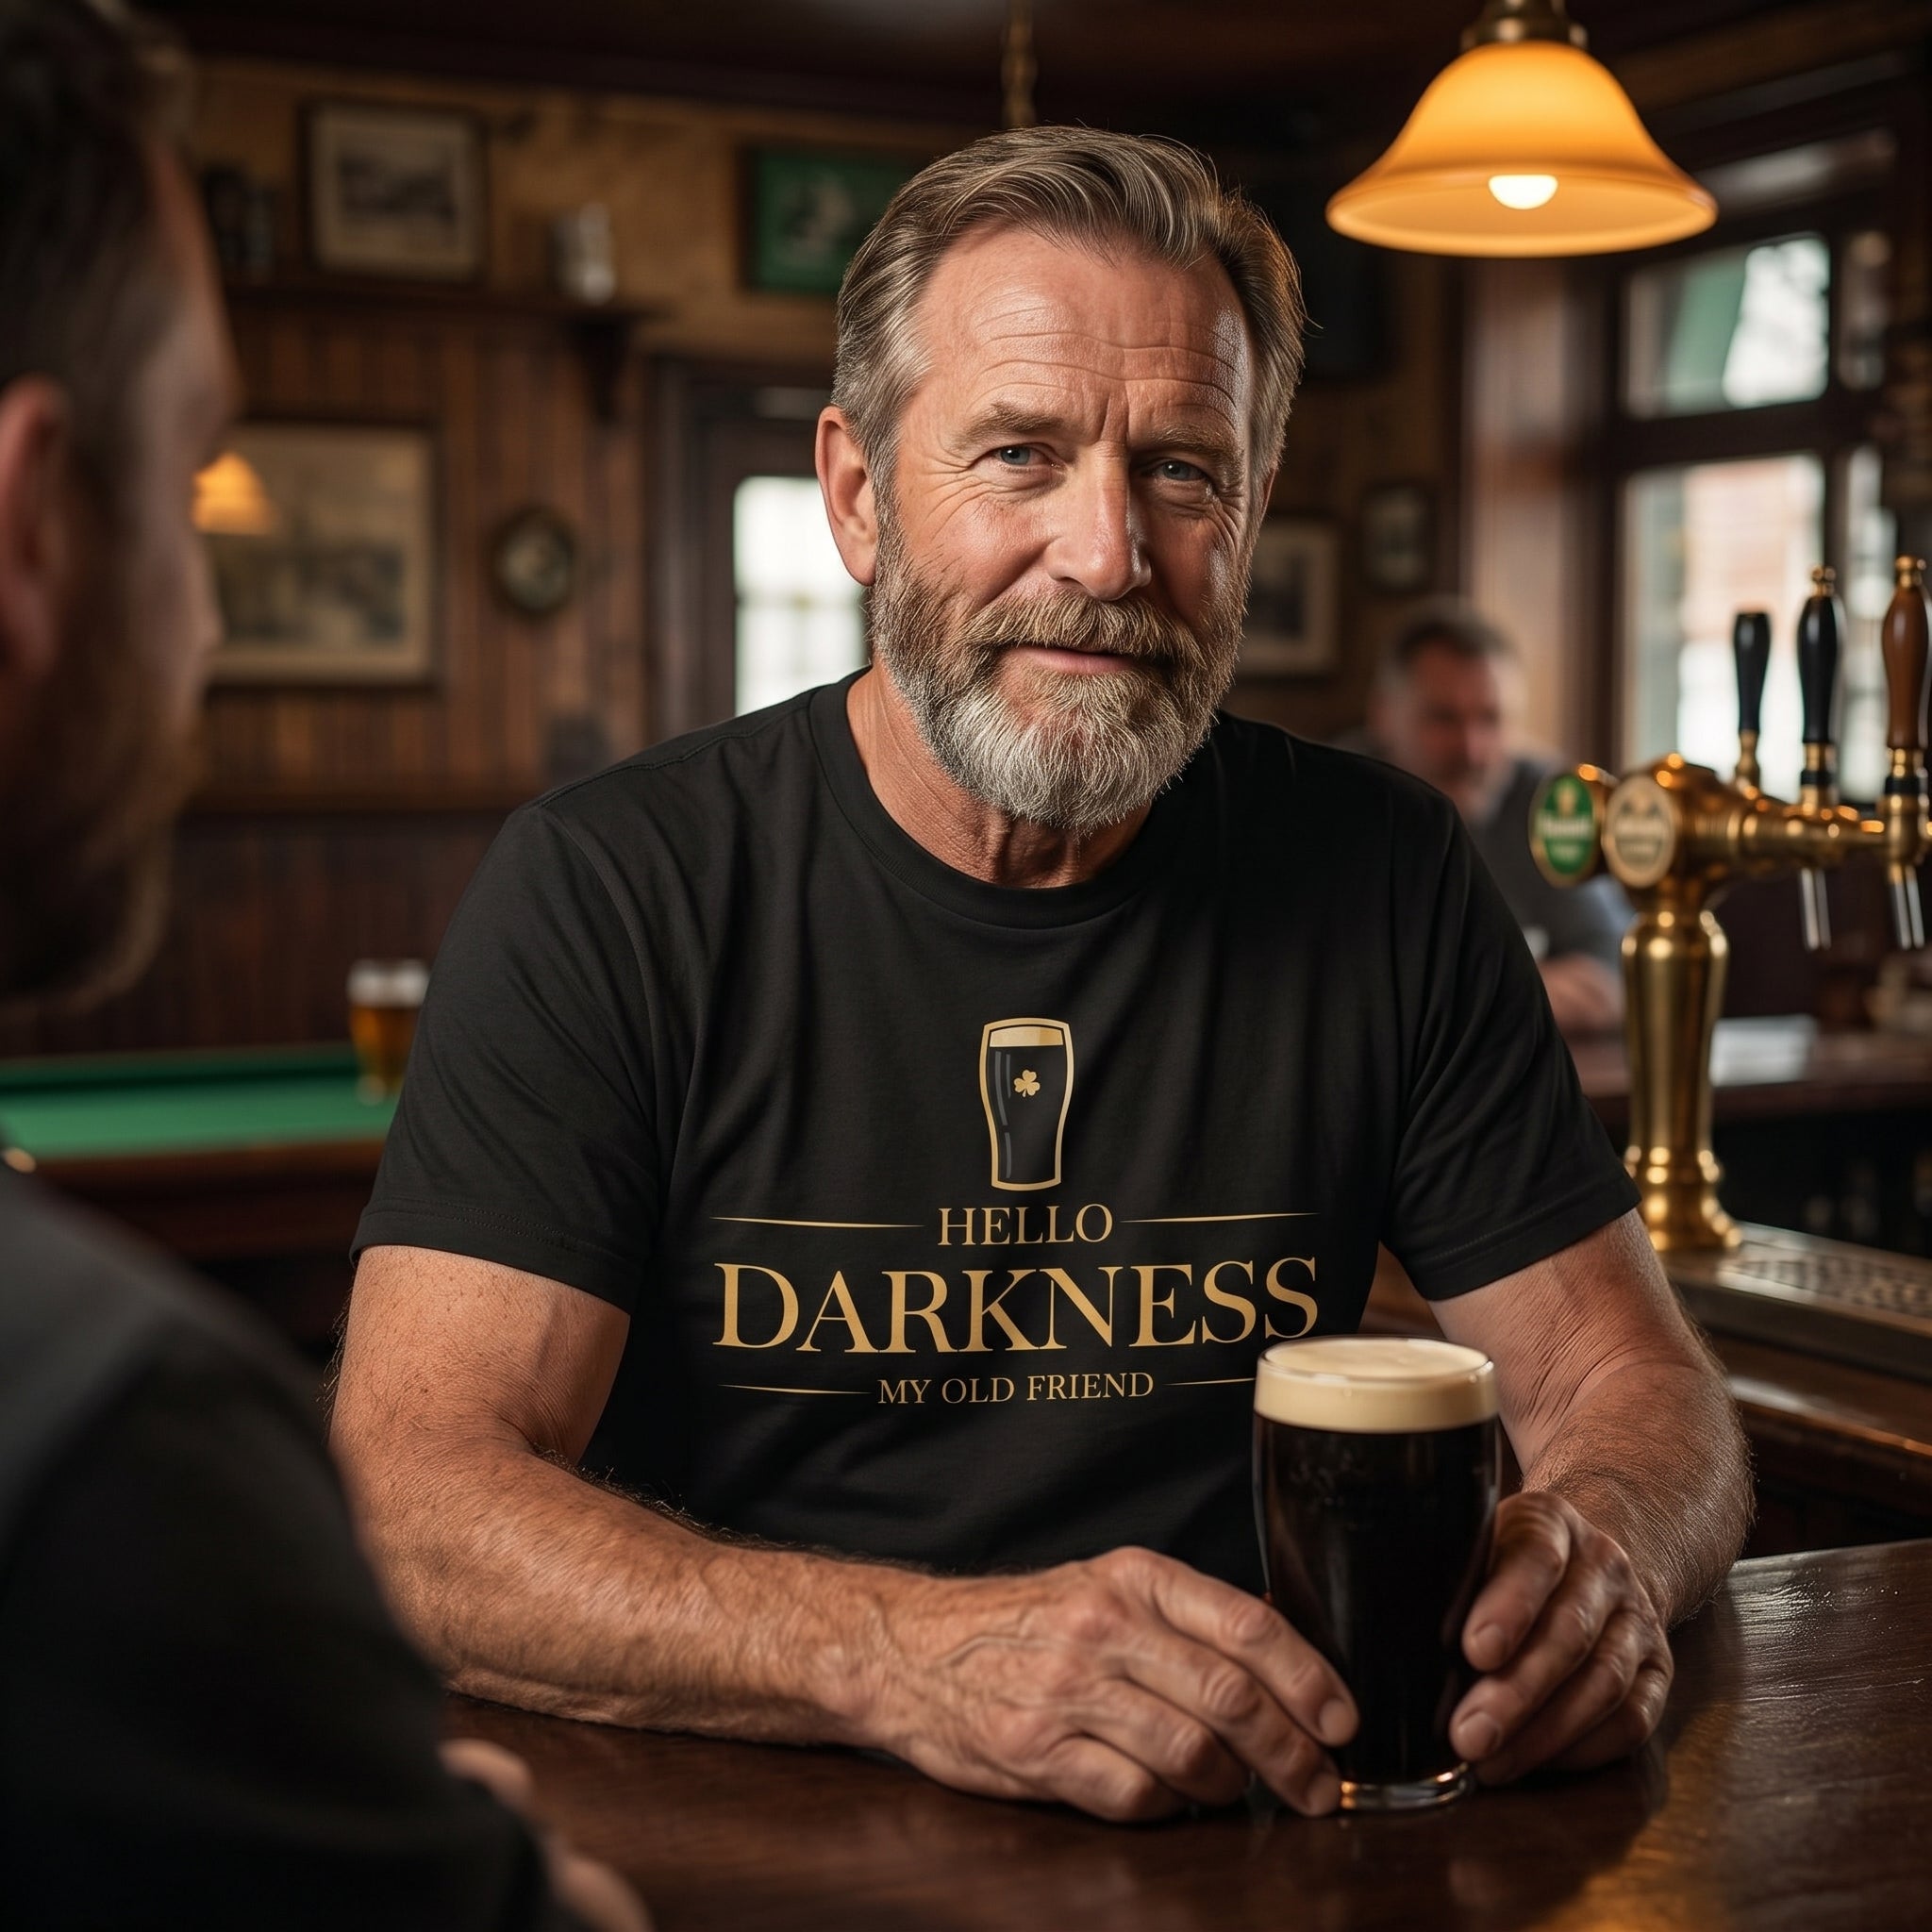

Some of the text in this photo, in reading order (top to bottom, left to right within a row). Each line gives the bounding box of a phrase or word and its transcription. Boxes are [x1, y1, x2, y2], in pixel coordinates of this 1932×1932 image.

[938, 1203, 1113, 1246] HELLO
[712, 1257, 1319, 1354] DARKNESS
[877, 1372, 1154, 1405] MY OLD FRIEND
